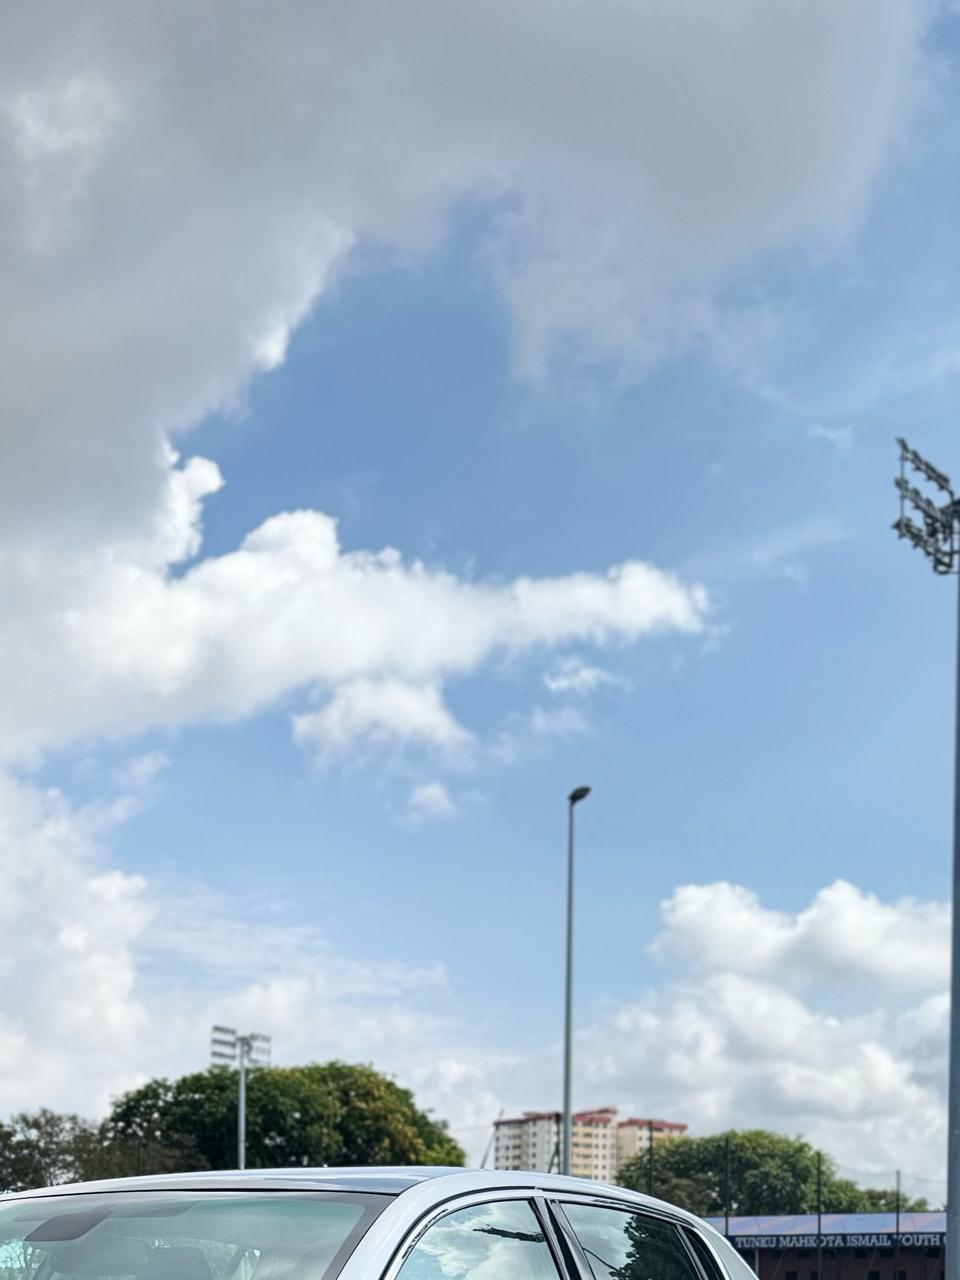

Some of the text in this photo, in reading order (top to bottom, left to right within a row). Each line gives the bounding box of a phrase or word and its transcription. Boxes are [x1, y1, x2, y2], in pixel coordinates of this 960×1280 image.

[735, 1237, 776, 1248] TUNKU
[779, 1235, 844, 1248] MAHKOTA
[846, 1234, 891, 1247] ISMAIL
